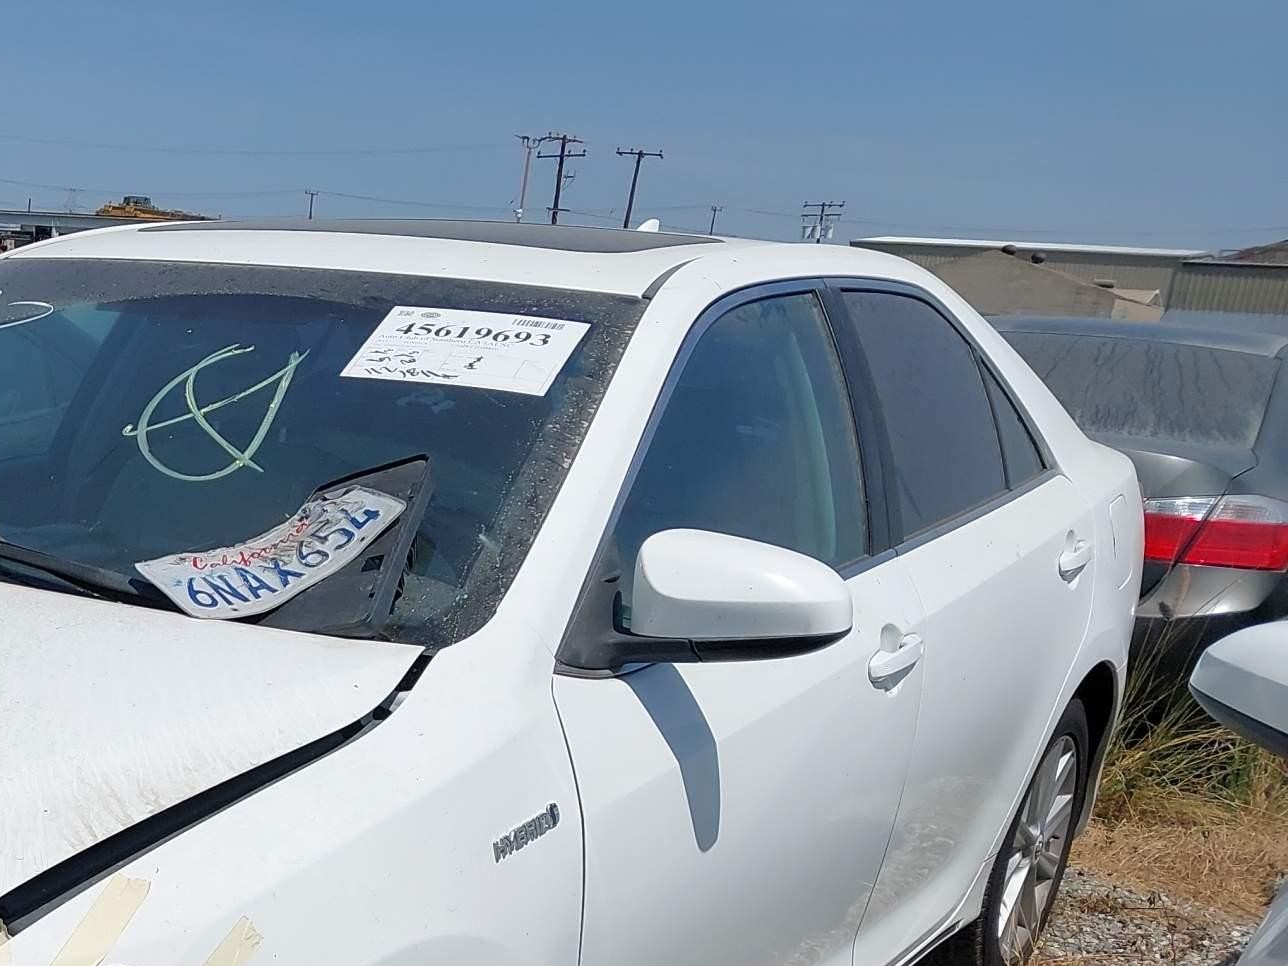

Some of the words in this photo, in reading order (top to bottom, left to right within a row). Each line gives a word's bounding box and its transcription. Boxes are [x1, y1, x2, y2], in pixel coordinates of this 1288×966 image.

[395, 322, 553, 347] 45619693
[186, 508, 383, 609] 6NAX654
[191, 517, 309, 570] California
[493, 803, 560, 863] HYBRID
